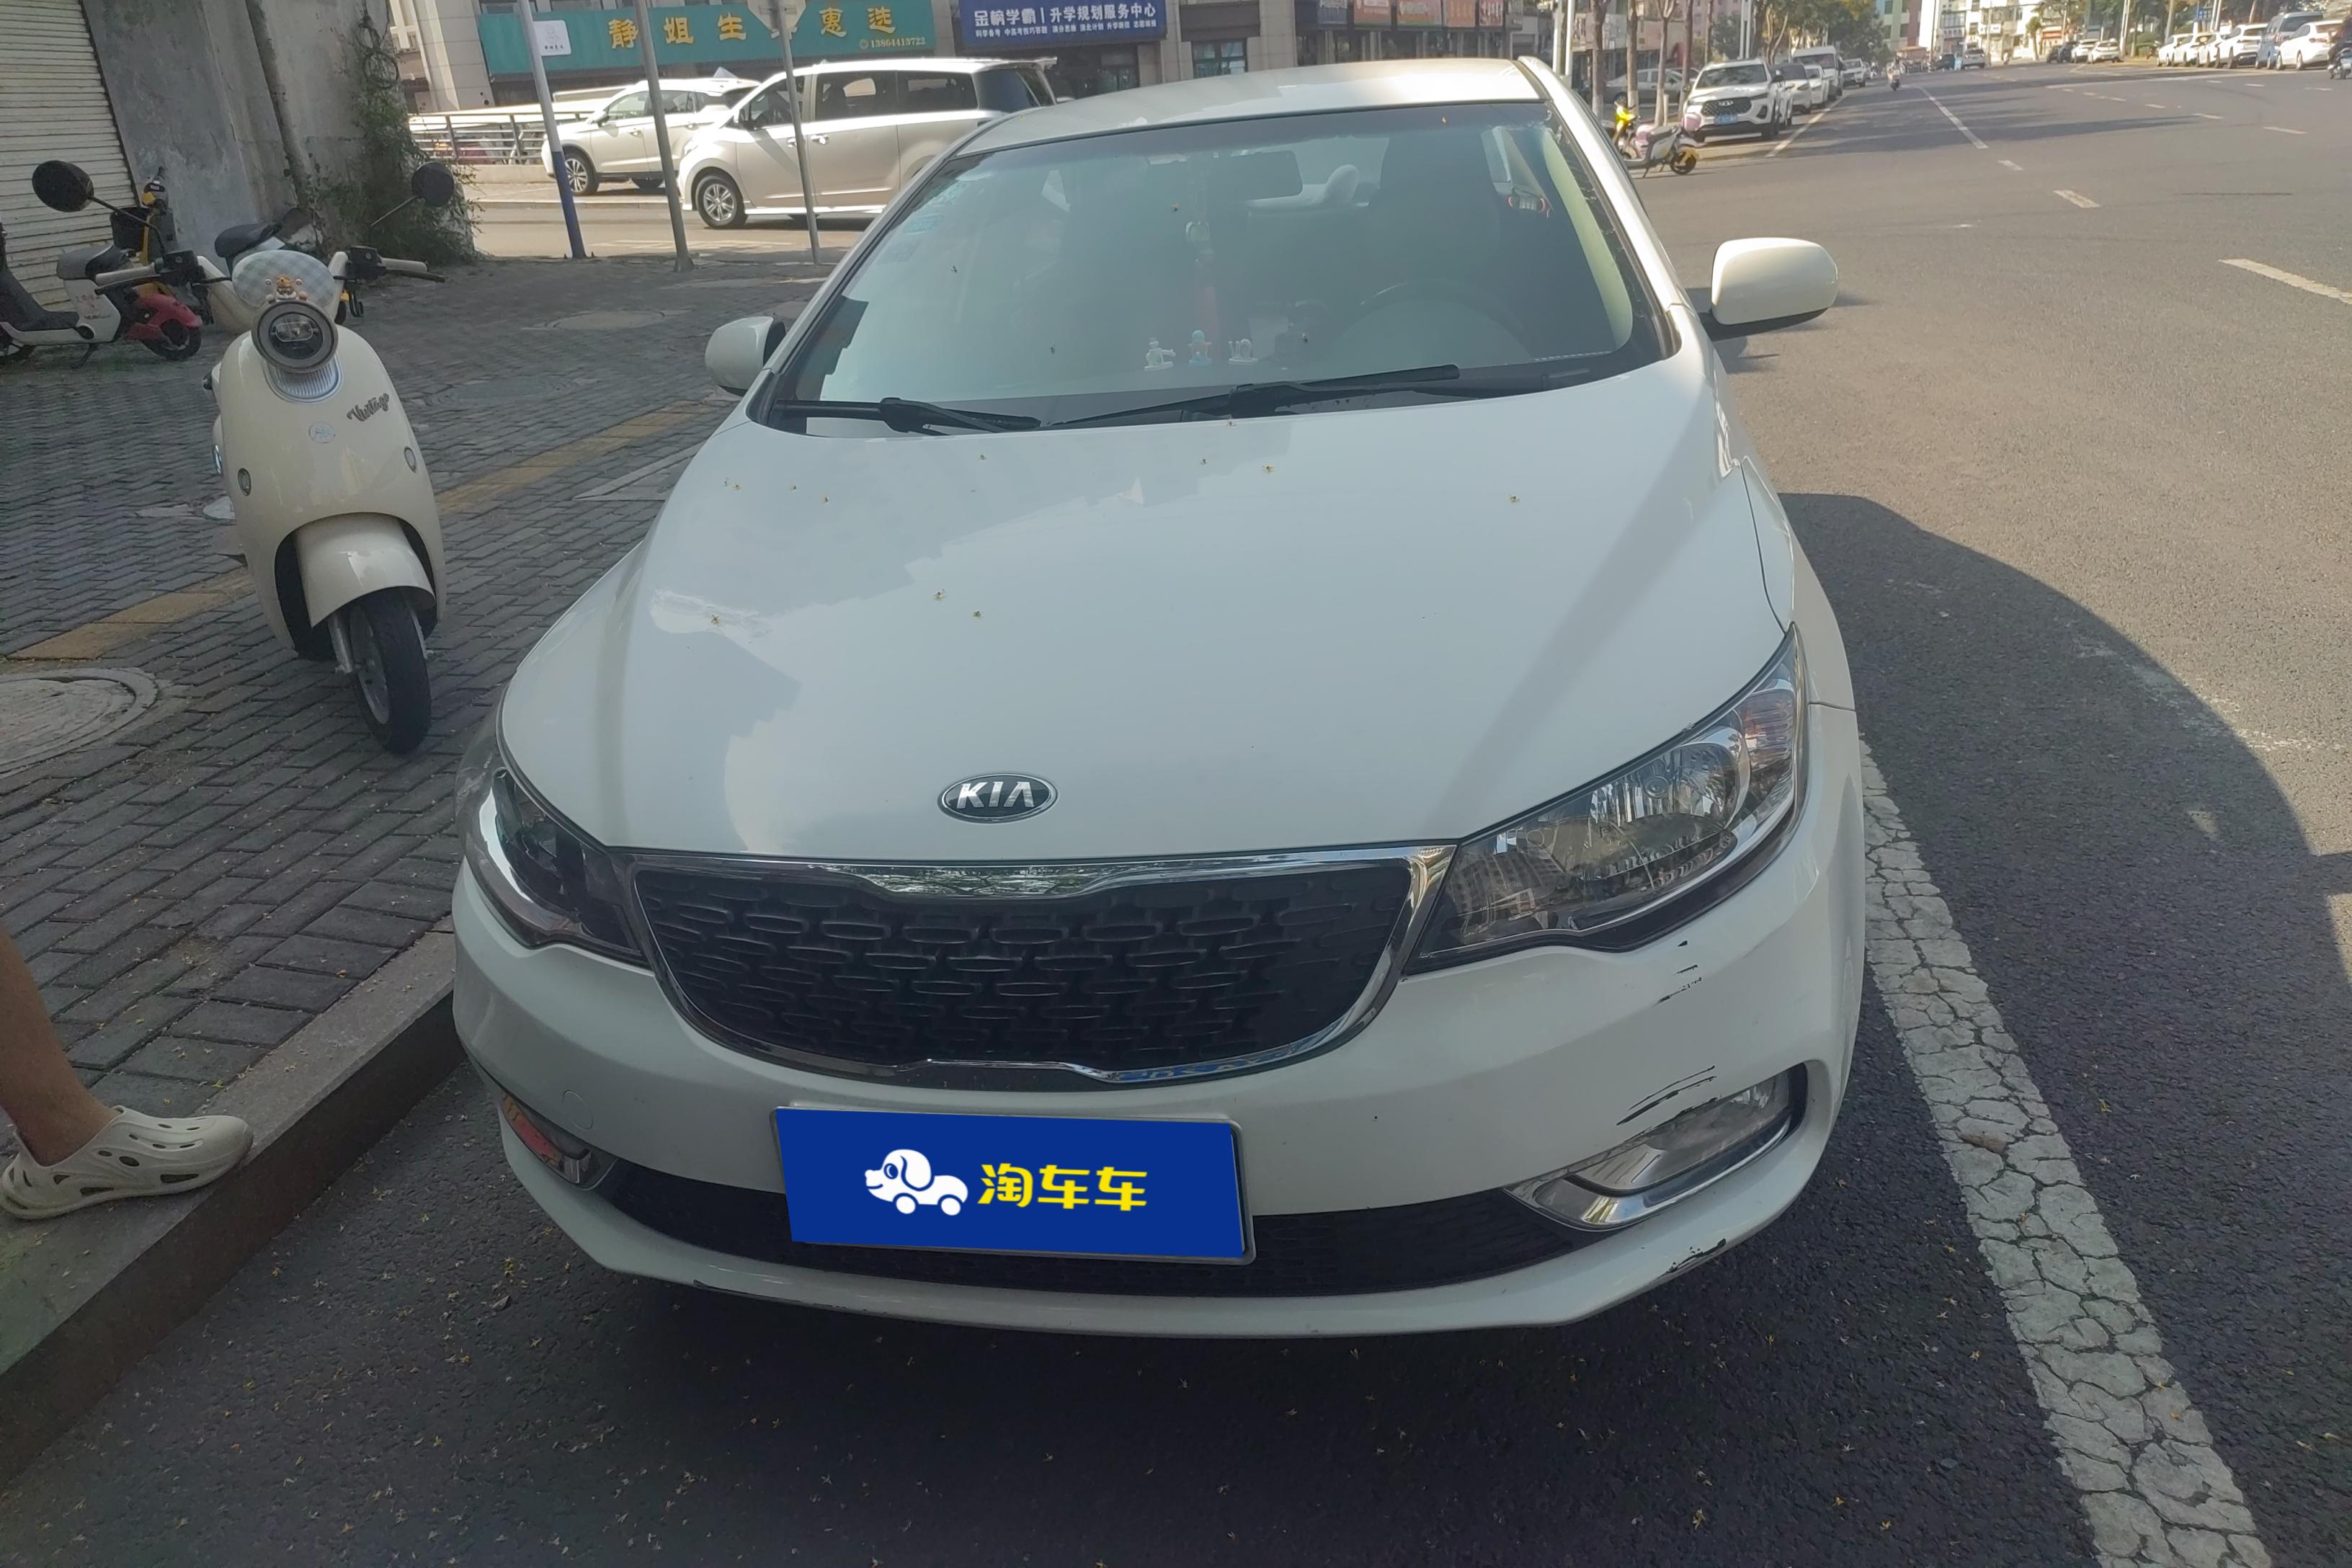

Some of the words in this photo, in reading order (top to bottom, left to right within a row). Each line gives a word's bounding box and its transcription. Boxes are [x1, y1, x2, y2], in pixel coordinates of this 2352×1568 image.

[1050, 3, 1156, 22] 升学规划服务中心
[608, 6, 896, 50] 静姐生惠选
[956, 781, 1034, 808] KIA
